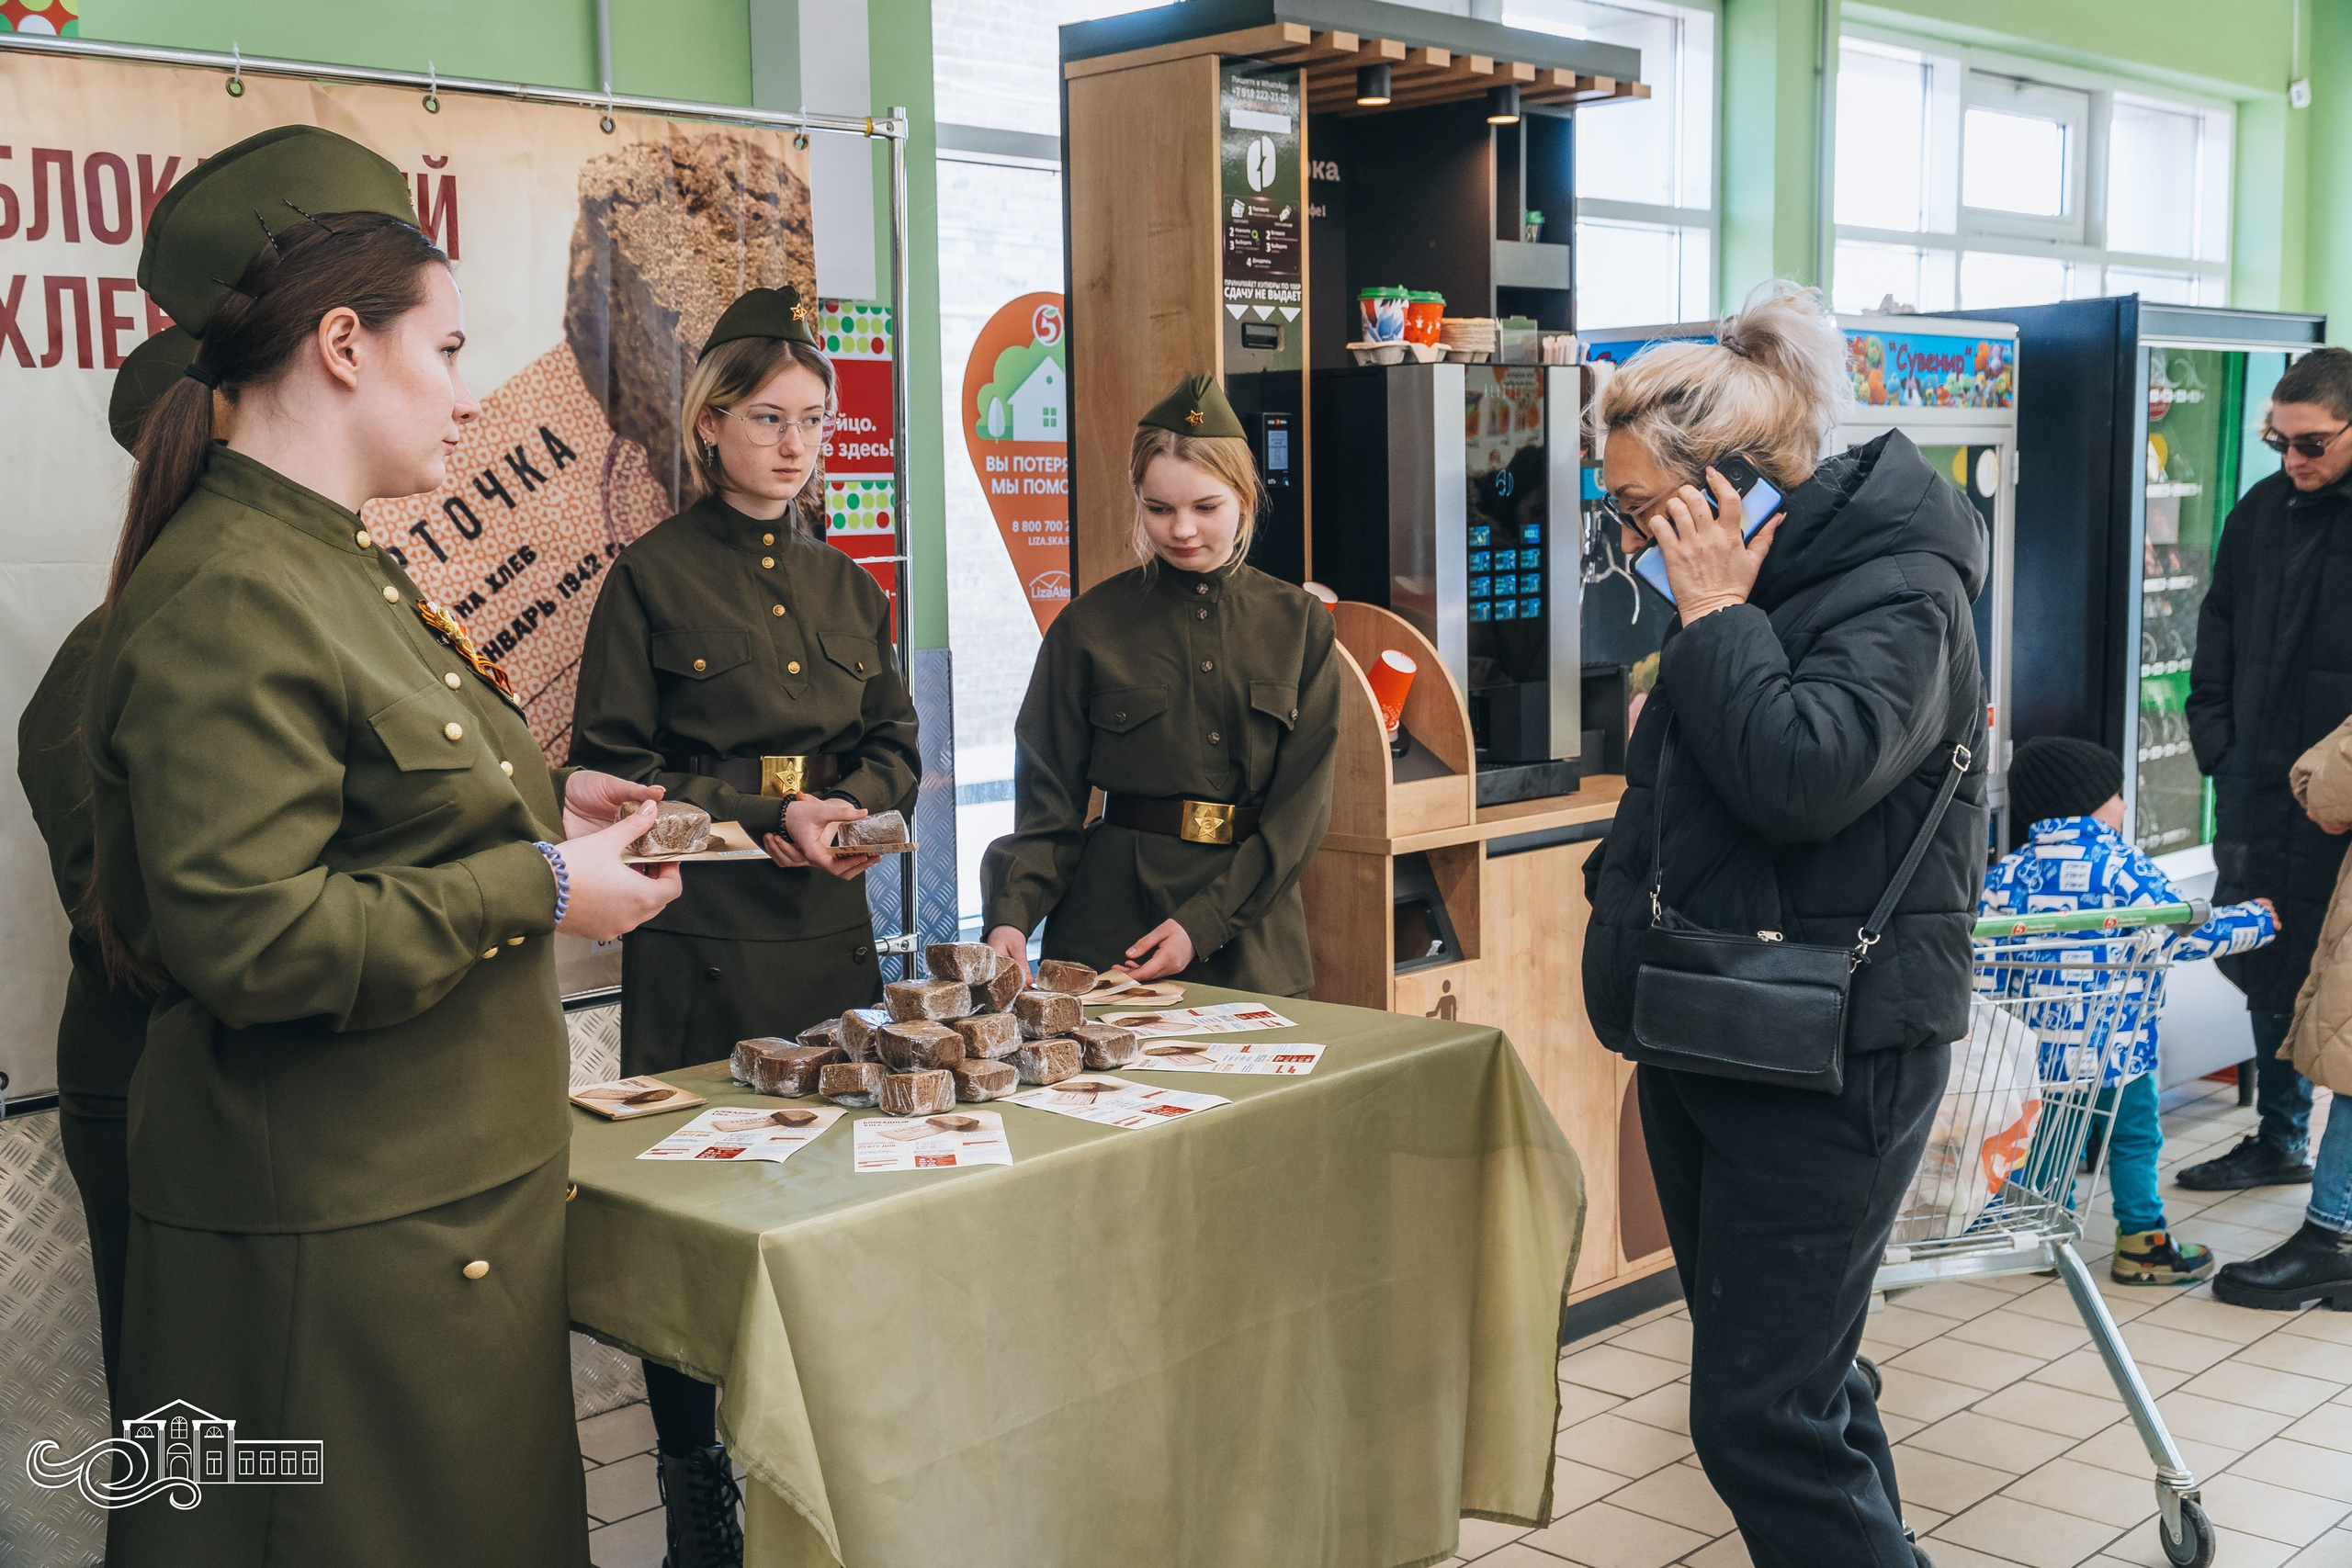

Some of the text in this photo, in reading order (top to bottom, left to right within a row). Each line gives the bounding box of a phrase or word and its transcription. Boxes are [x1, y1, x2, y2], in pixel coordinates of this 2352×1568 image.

[1224, 287, 1302, 303] СДАЧУ НЕ ВЫДАЕТ
[838, 437, 895, 460] здесь!
[986, 456, 1069, 472] ВЫ ПОТЕРЯ
[991, 478, 1019, 495] МЫ
[1012, 520, 1019, 533] 8
[1022, 520, 1042, 533] 800
[1044, 520, 1063, 533] 700
[454, 545, 537, 618] НА ХЛЕБ
[476, 599, 557, 664] НВАРЬ
[556, 553, 603, 599] 1942
